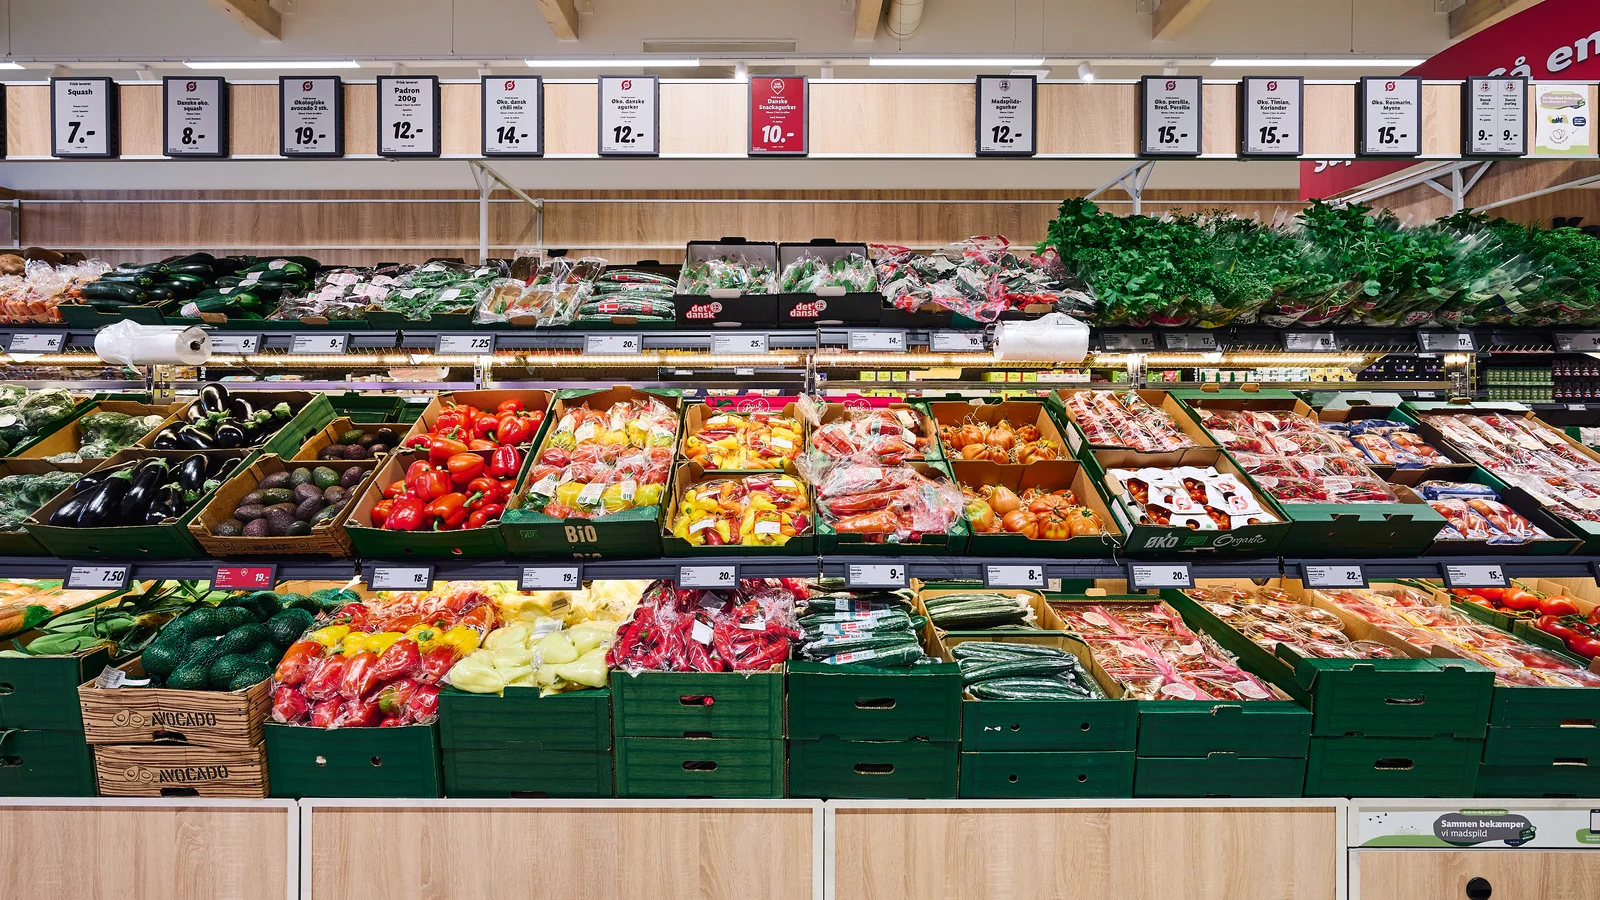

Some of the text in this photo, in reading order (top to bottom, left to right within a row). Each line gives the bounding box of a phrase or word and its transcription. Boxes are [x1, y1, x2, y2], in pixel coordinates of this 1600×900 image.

[398, 95, 416, 103] 200g
[68, 122, 95, 143] 7.-
[393, 122, 423, 139] 12.-
[496, 126, 528, 144] 14.-
[613, 125, 644, 143] 12.-
[762, 125, 794, 143] 10.-
[992, 125, 1022, 143] 12.-
[1158, 126, 1188, 144] 15.-
[1259, 126, 1289, 144] 15.-
[1378, 126, 1407, 144] 15.-
[1478, 129, 1493, 141] 9.-
[1503, 129, 1518, 141] 9.-
[182, 127, 205, 145] 8.-
[295, 127, 326, 145] 19.-
[686, 311, 716, 319] dansk
[790, 309, 819, 317] dansk
[47, 338, 59, 346] 16.-
[242, 339, 255, 348] 9.-
[330, 339, 342, 348] 9.-
[471, 339, 490, 348] 7.25
[1458, 338, 1471, 346] 17.-
[1144, 533, 1267, 548] ØKO Organic
[102, 571, 124, 581] 7.50
[255, 573, 269, 582] 19.-
[414, 574, 428, 582] 18.-
[563, 573, 577, 581] 19.-
[719, 572, 734, 580] 20.-
[890, 568, 904, 579] 9.-
[1028, 569, 1042, 580] 8.-
[1173, 571, 1188, 580] 20.-
[1346, 571, 1361, 580] 22.-
[1488, 571, 1502, 579] 15.-
[151, 712, 217, 726] AVOCADO
[159, 765, 229, 783] AVOCADO
[1441, 819, 1525, 829] Sammen bekæmper
[1451, 829, 1488, 838] madspild
